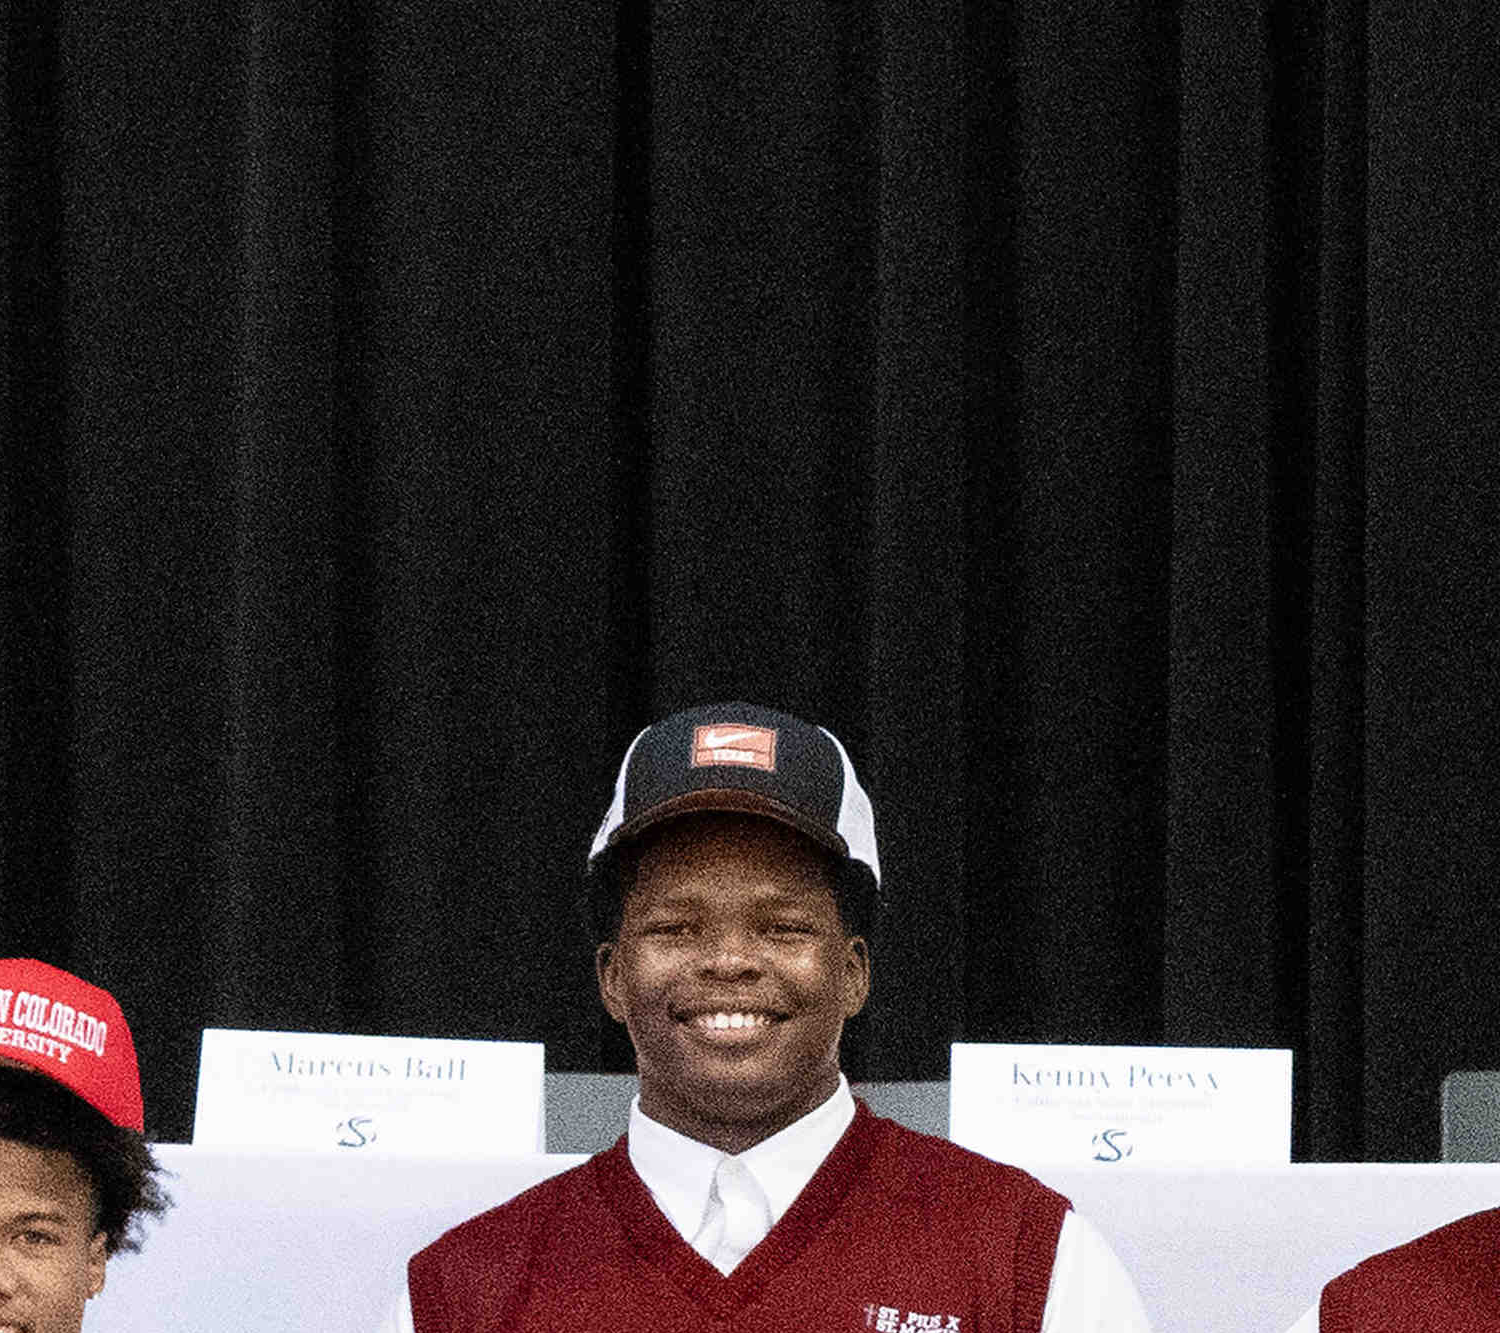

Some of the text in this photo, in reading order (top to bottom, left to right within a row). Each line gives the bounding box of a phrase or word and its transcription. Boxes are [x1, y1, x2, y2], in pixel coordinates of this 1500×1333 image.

[12, 991, 107, 1057] COLORADO
[270, 1050, 468, 1081] Marcus Ball
[1011, 1062, 1112, 1093] Kenny
